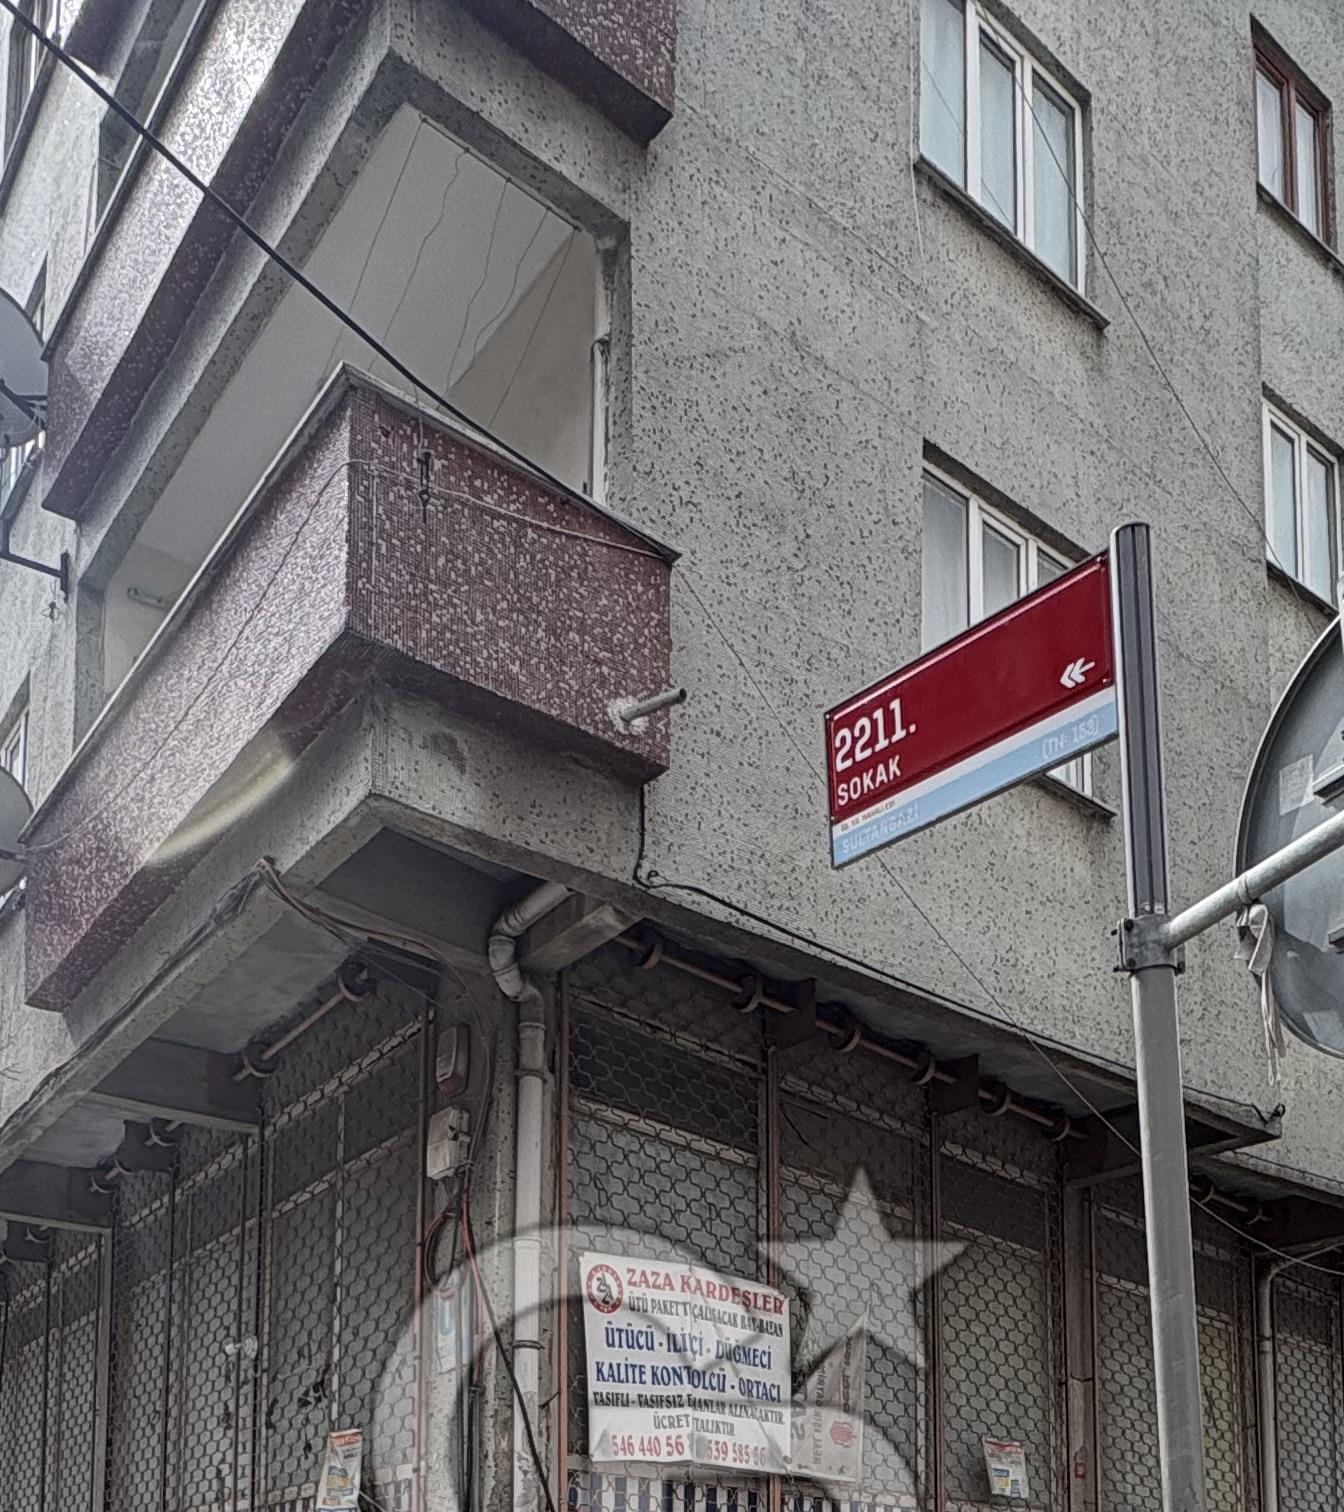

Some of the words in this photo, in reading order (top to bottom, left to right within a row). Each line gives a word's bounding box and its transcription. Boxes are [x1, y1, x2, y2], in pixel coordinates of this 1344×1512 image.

[834, 698, 917, 773] 2211.
[837, 755, 902, 806] SOKAK
[626, 1268, 675, 1291] ZAZA
[680, 1274, 785, 1316] KARDEŞLER
[628, 1291, 648, 1312] ÜTÜ
[605, 1321, 655, 1351] ÜTÜCÜ
[715, 1336, 772, 1370] DÜĞMECİ
[595, 1357, 647, 1385] KALİTE
[639, 1435, 661, 1457] 440
[665, 1434, 685, 1456] 56
